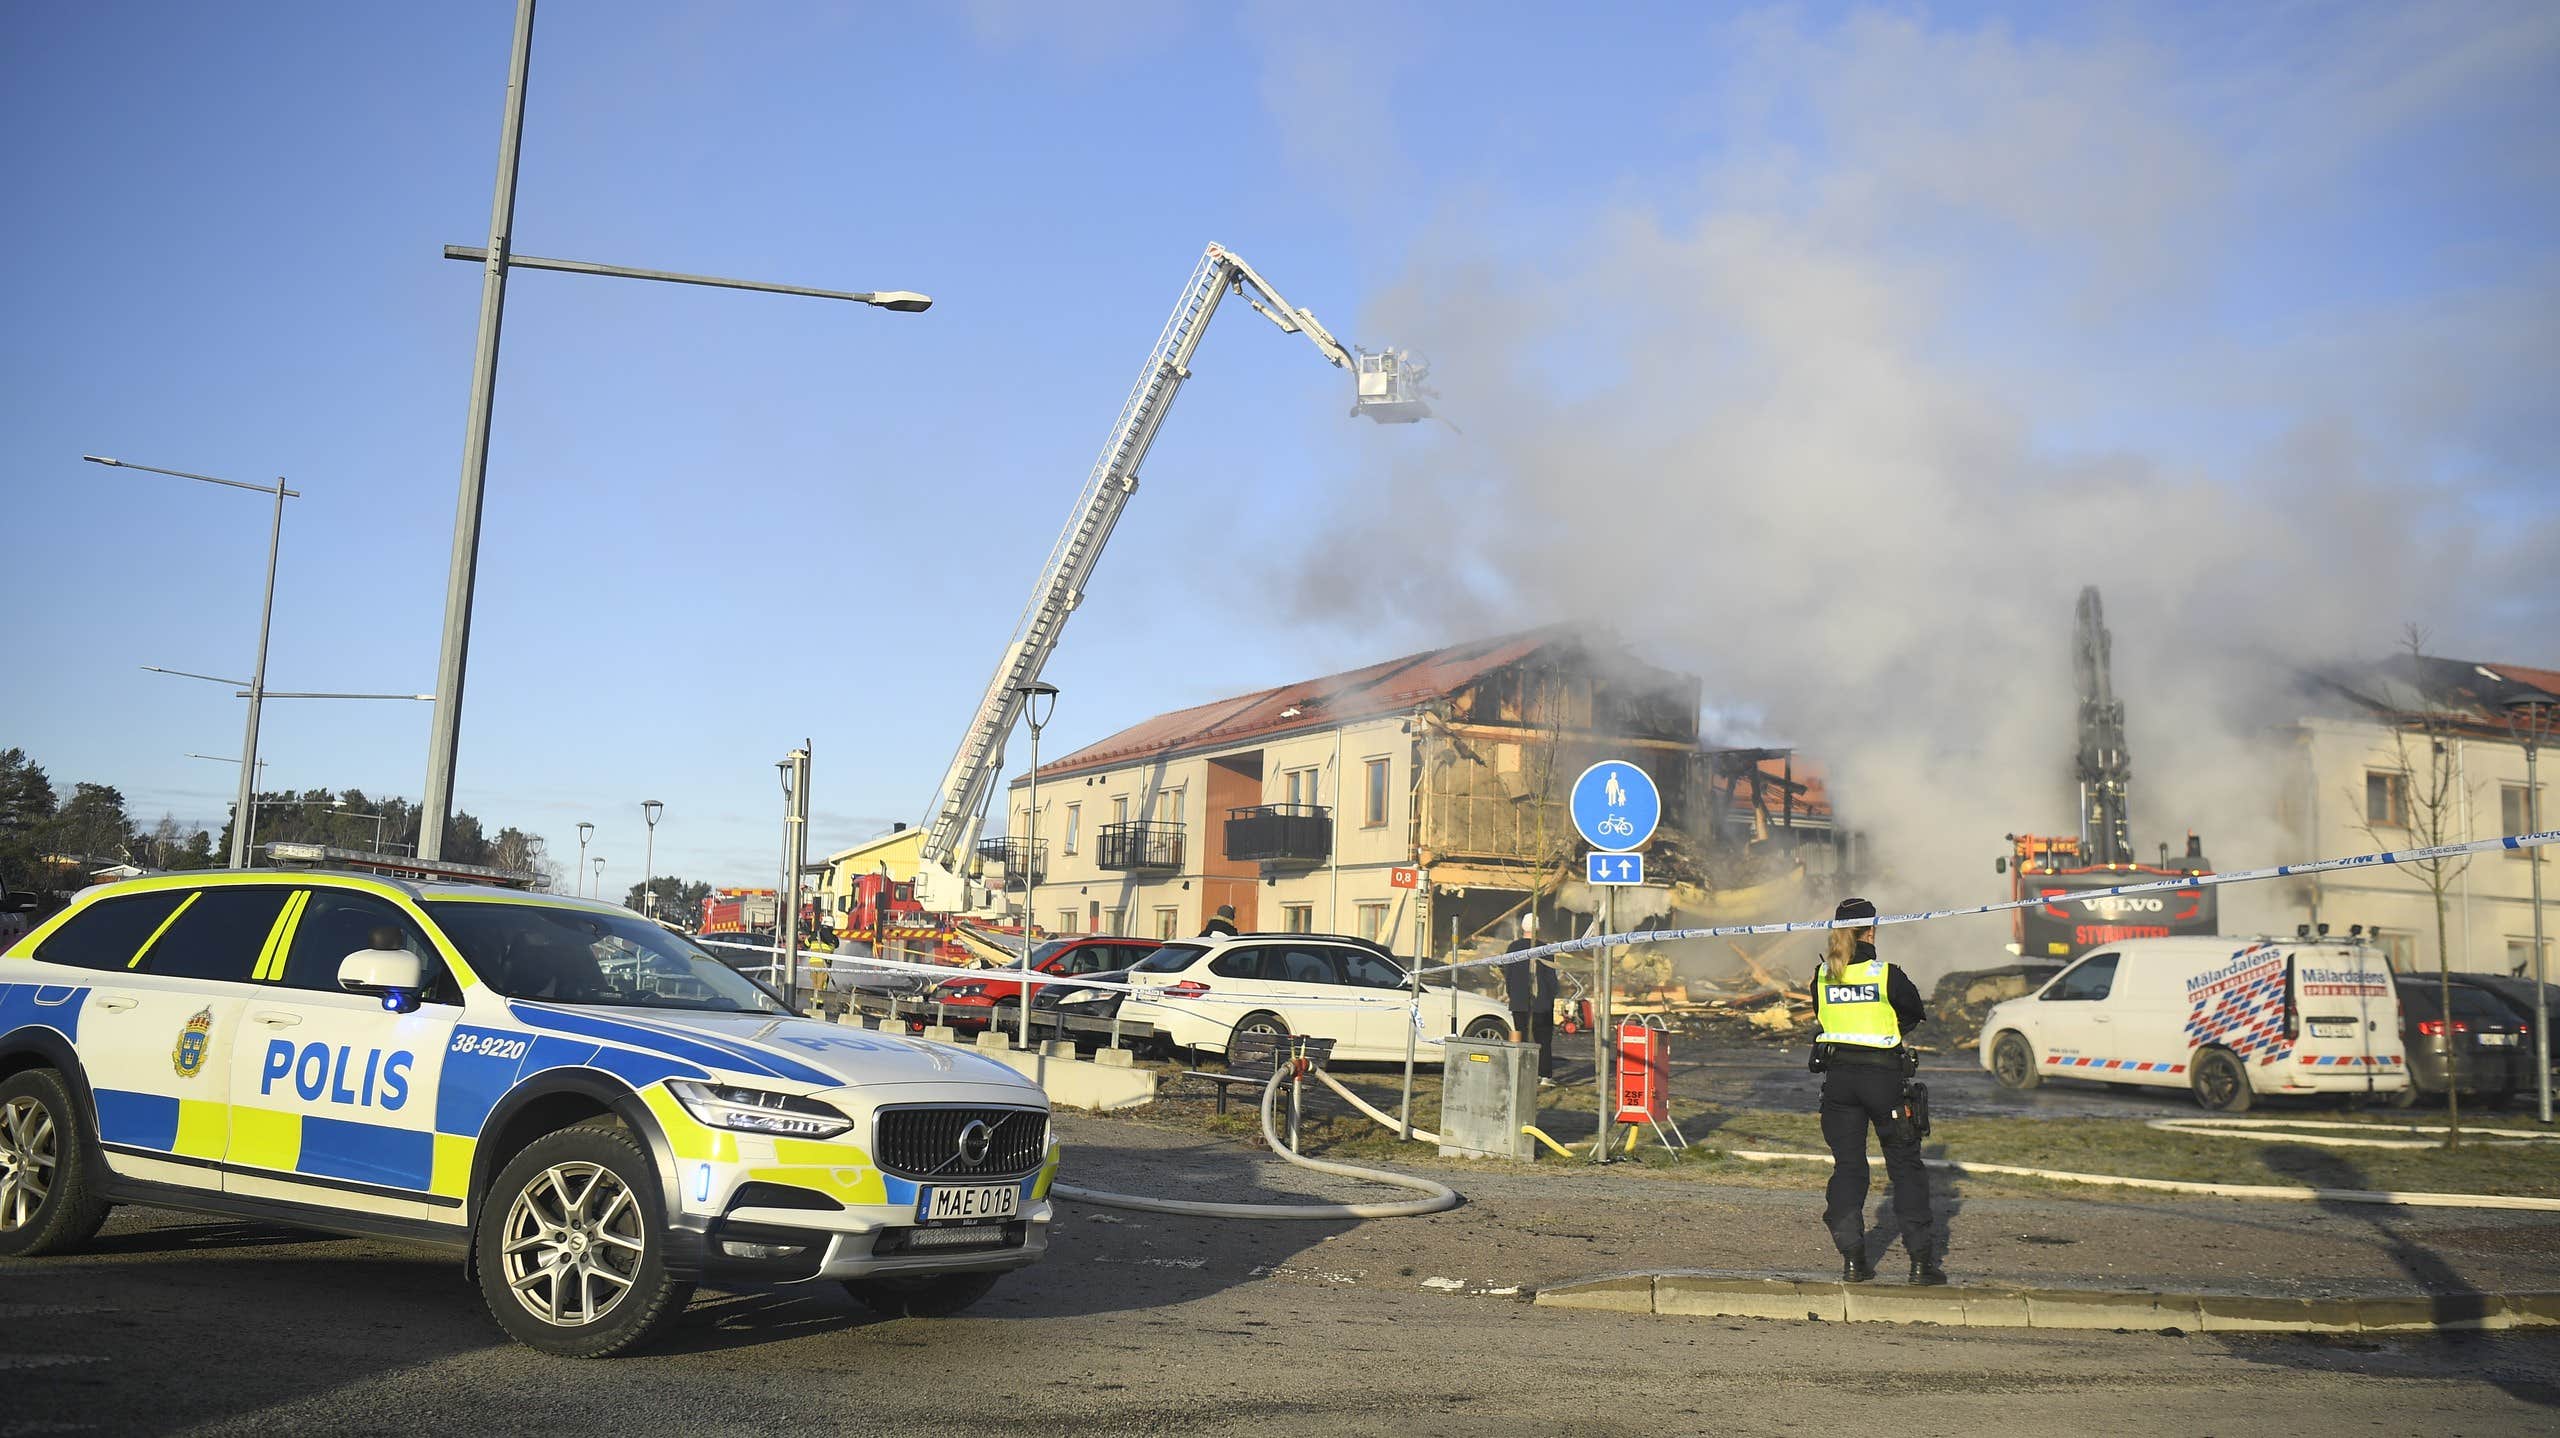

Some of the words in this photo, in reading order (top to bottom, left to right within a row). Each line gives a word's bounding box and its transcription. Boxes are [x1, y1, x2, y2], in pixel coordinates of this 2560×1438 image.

[1395, 872, 1412, 885] 0,8
[2080, 898, 2164, 912] VOLVO
[1829, 985, 1875, 1002] POLIS
[451, 1033, 526, 1060] 38-9220
[260, 1039, 414, 1111] POLIS
[936, 1190, 975, 1216] MAE
[980, 1188, 1012, 1213] 01B
